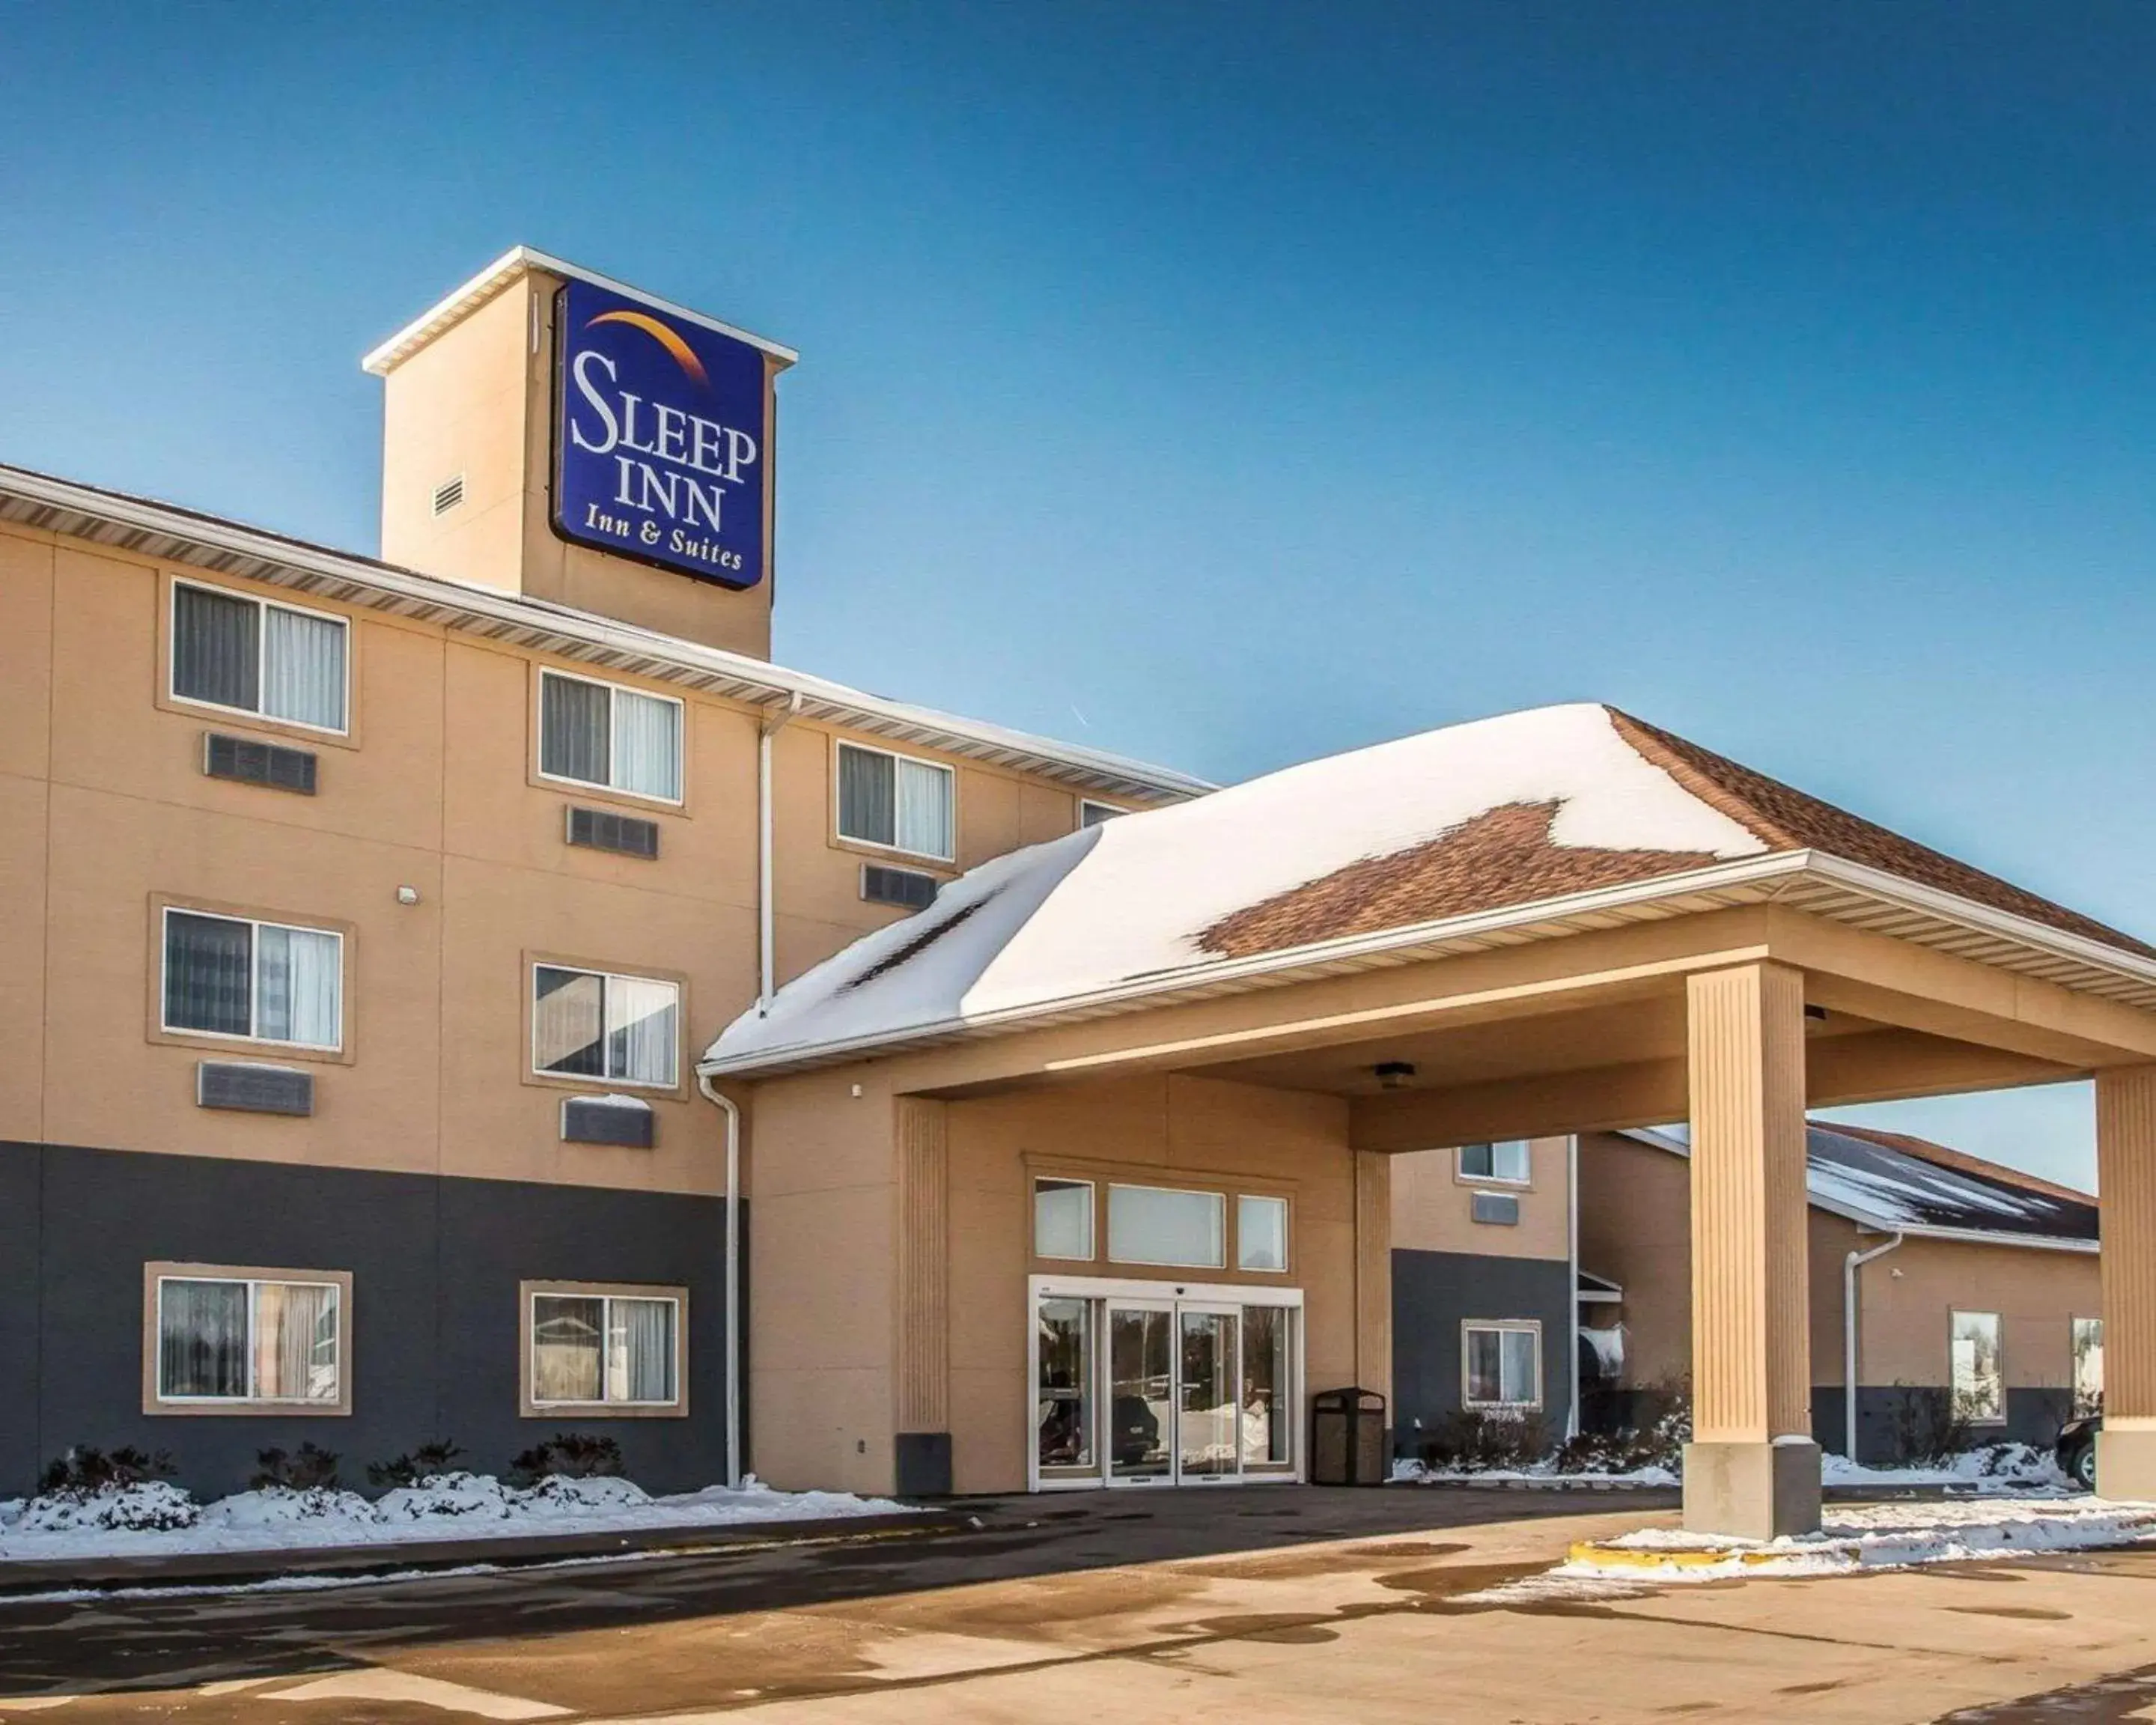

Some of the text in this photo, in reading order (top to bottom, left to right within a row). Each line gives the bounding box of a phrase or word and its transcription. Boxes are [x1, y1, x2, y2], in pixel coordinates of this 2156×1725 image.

[571, 350, 756, 484] SLEEP
[615, 455, 725, 532] INN
[585, 503, 743, 570] Inn & Suites
